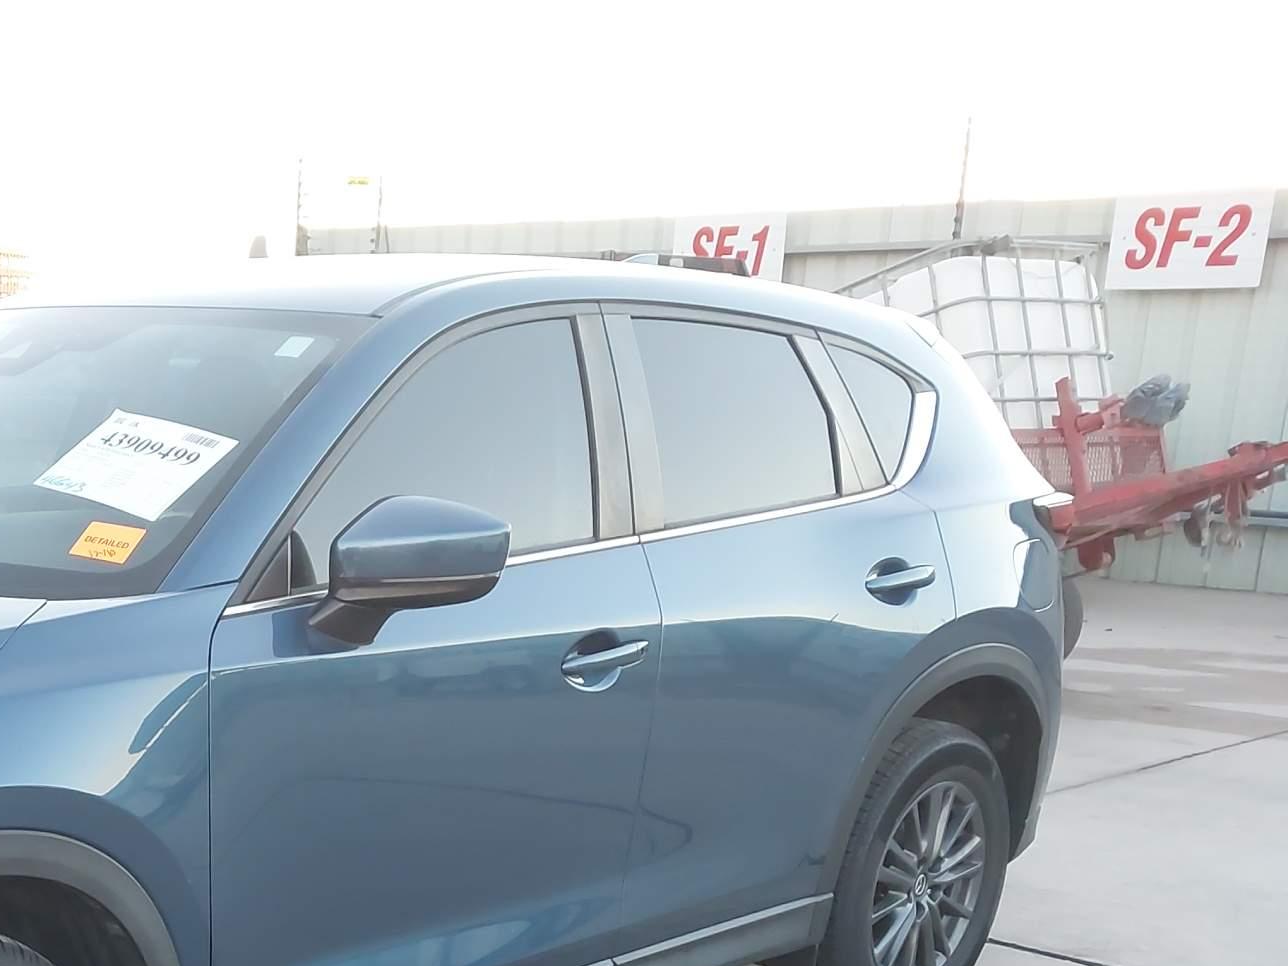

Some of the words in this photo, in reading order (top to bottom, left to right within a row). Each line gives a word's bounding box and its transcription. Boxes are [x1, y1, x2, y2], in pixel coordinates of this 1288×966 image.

[1124, 204, 1253, 270] SF-2
[101, 431, 201, 466] 43909499
[84, 535, 130, 550] DETAILED
